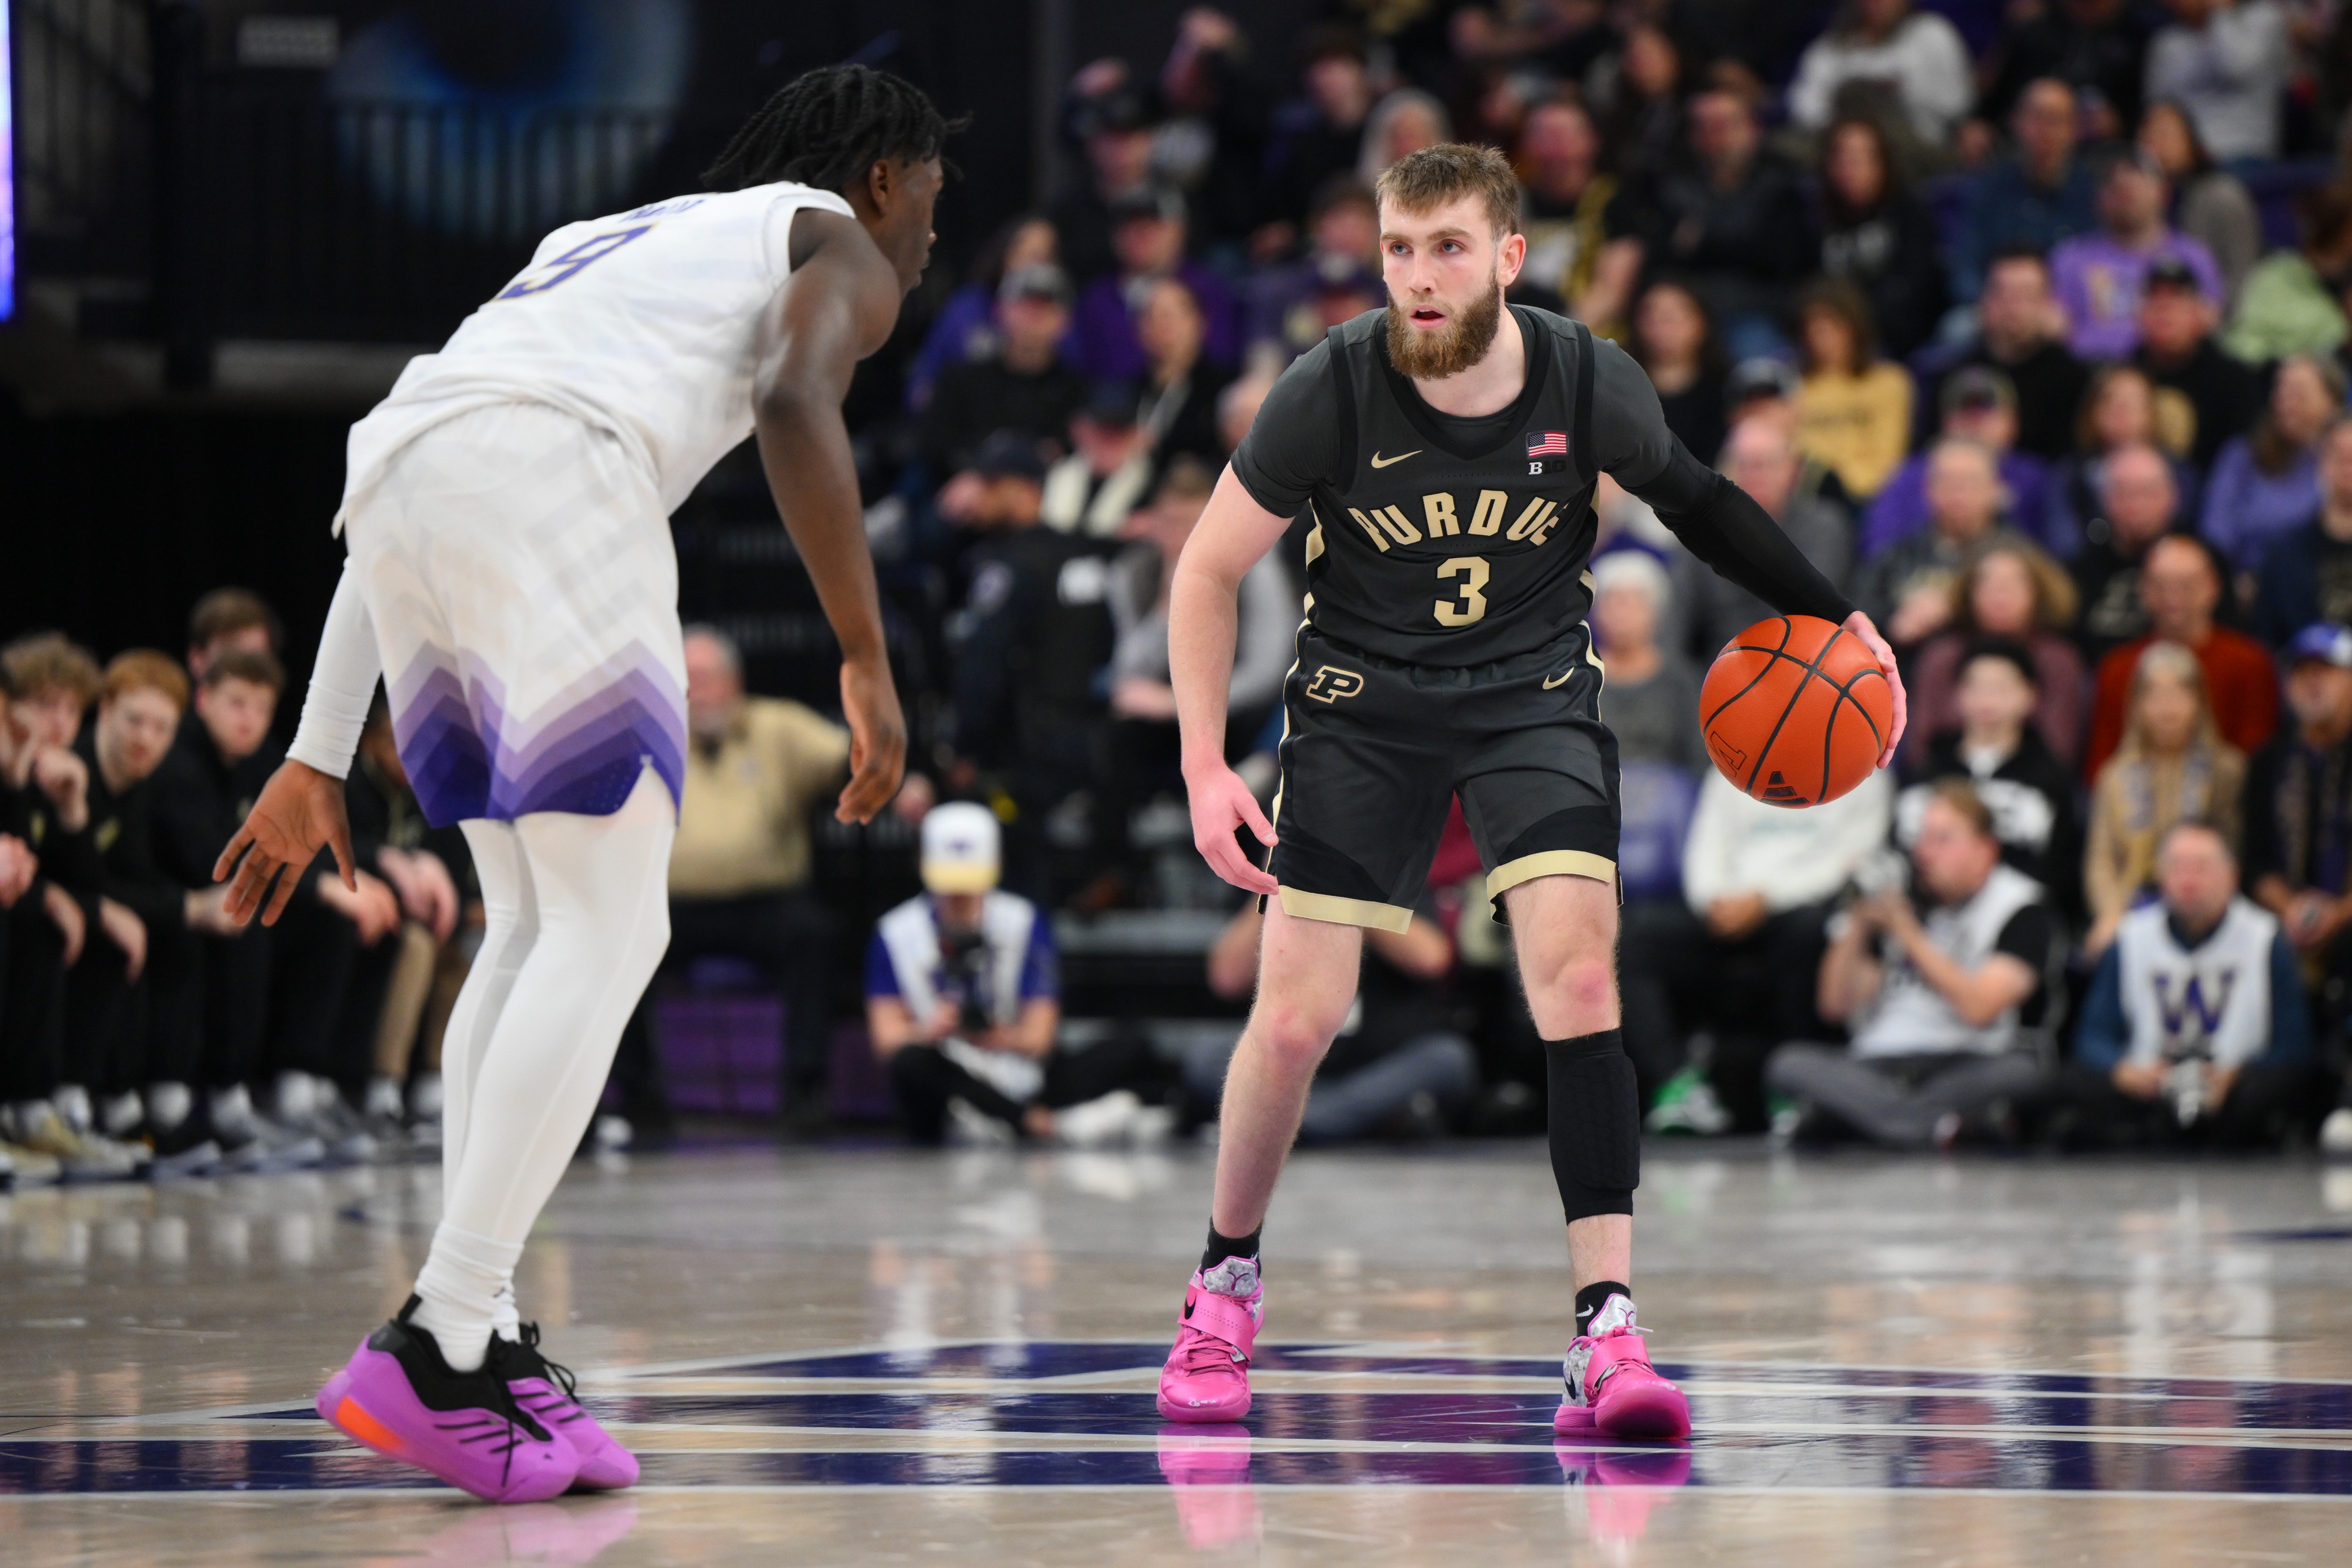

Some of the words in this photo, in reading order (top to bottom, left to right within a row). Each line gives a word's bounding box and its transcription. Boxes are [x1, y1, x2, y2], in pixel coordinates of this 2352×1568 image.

[494, 222, 659, 301] 9
[1347, 489, 1569, 553] PURDUE
[1434, 556, 1490, 626] 3
[1305, 665, 1363, 703] P
[2152, 967, 2235, 1036] W
